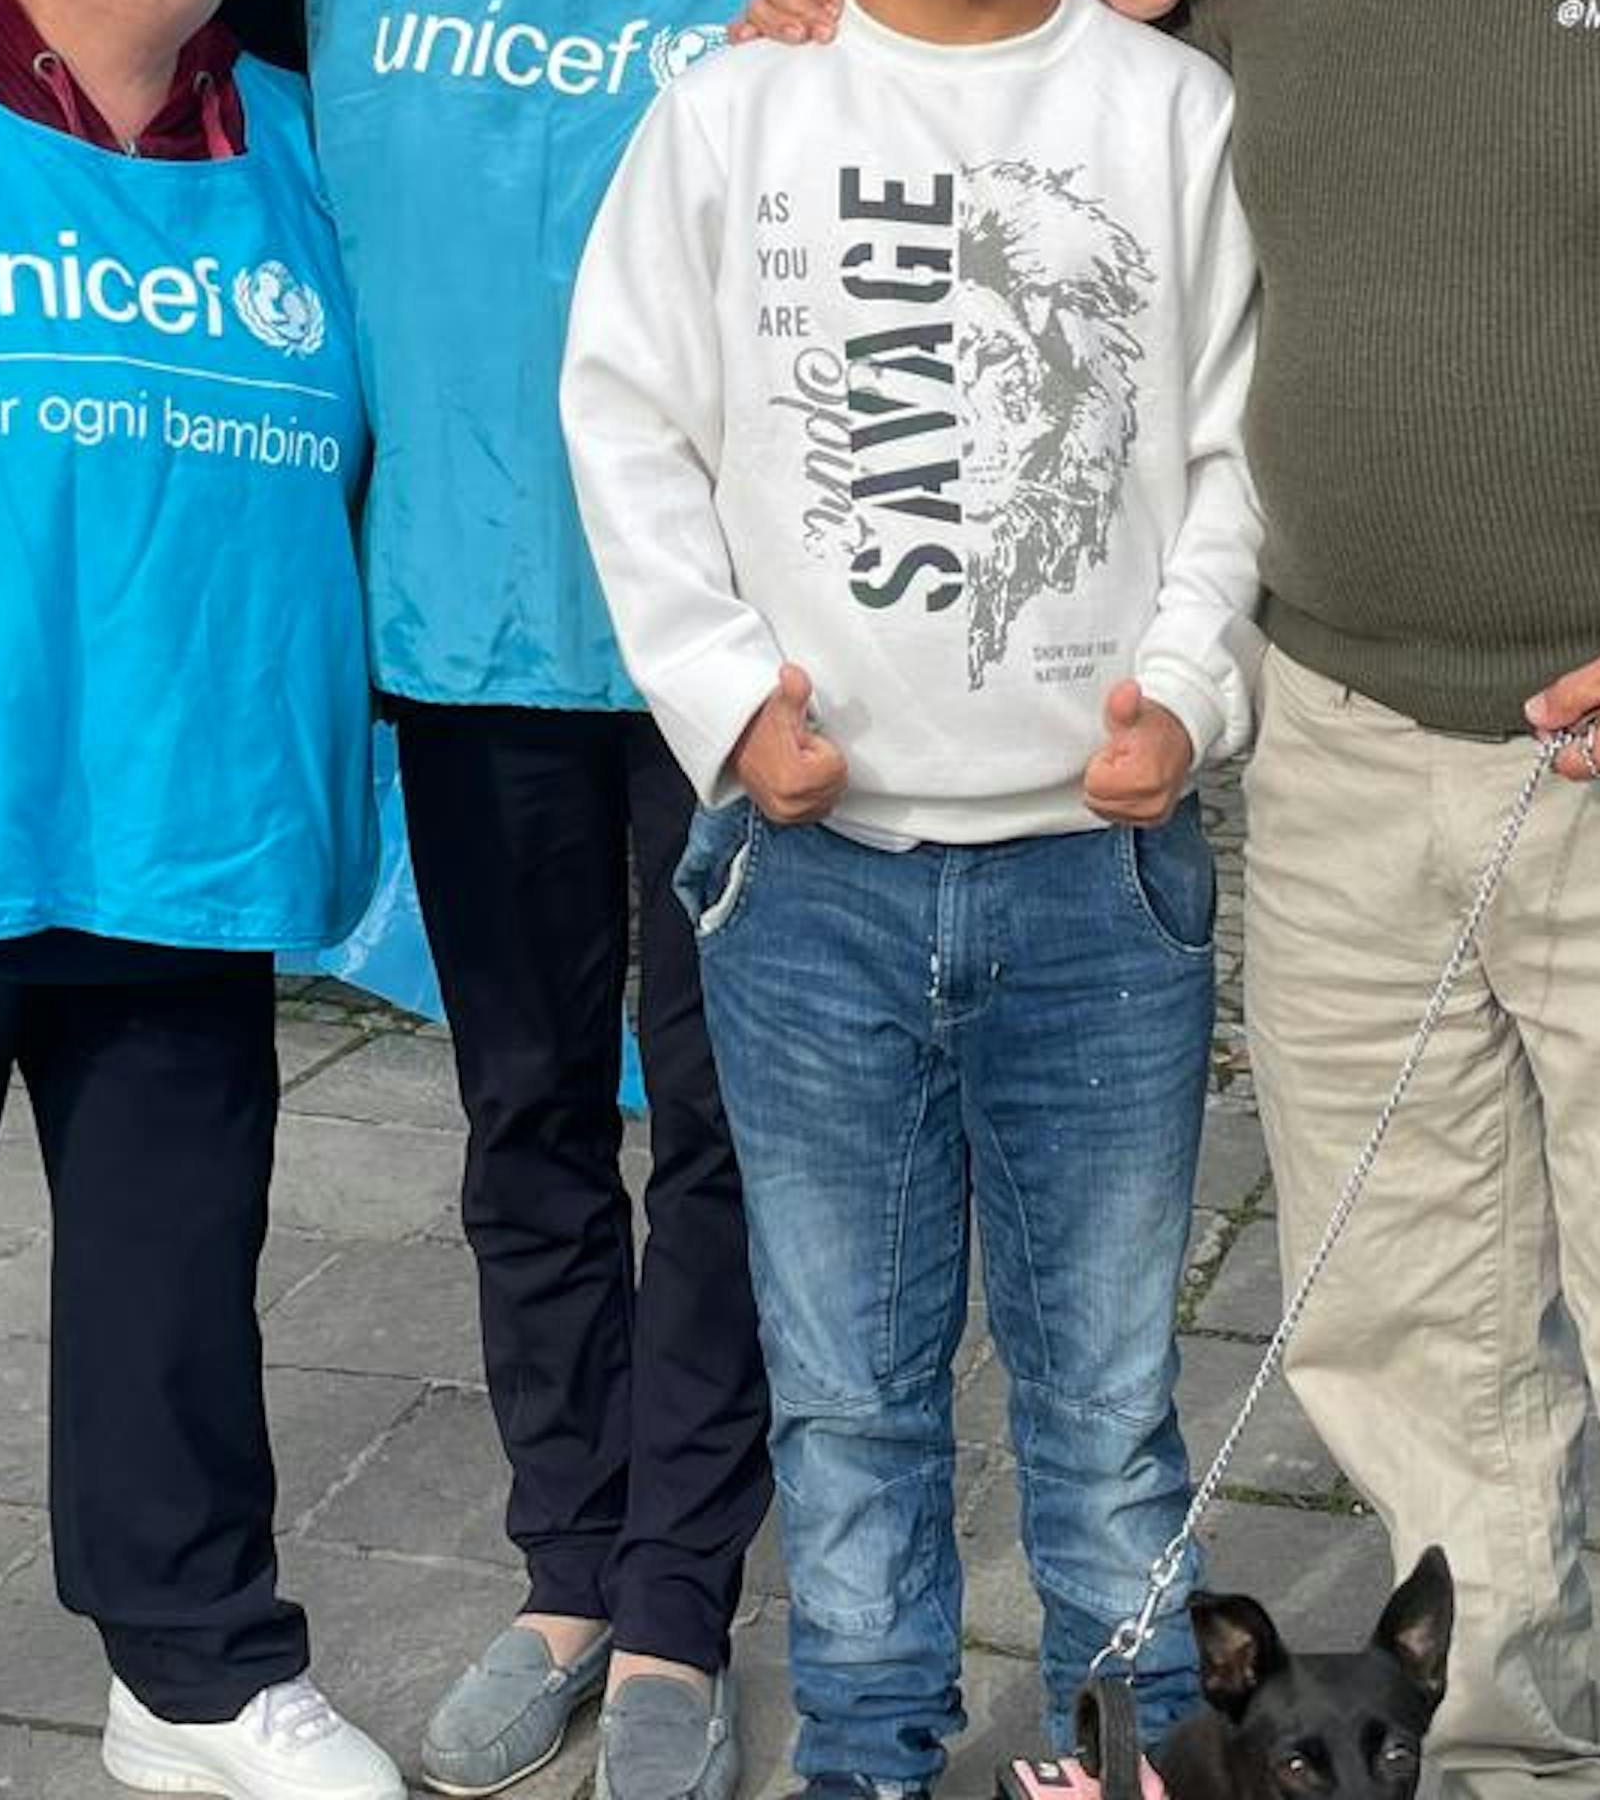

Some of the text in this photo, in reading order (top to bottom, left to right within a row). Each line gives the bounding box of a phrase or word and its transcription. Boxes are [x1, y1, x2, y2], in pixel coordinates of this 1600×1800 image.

[757, 192, 789, 224] AS
[757, 249, 808, 281] YOU
[757, 306, 809, 339] ARE
[838, 166, 963, 613] SAVAGE
[38, 390, 148, 445] ogni
[165, 397, 340, 474] bambino
